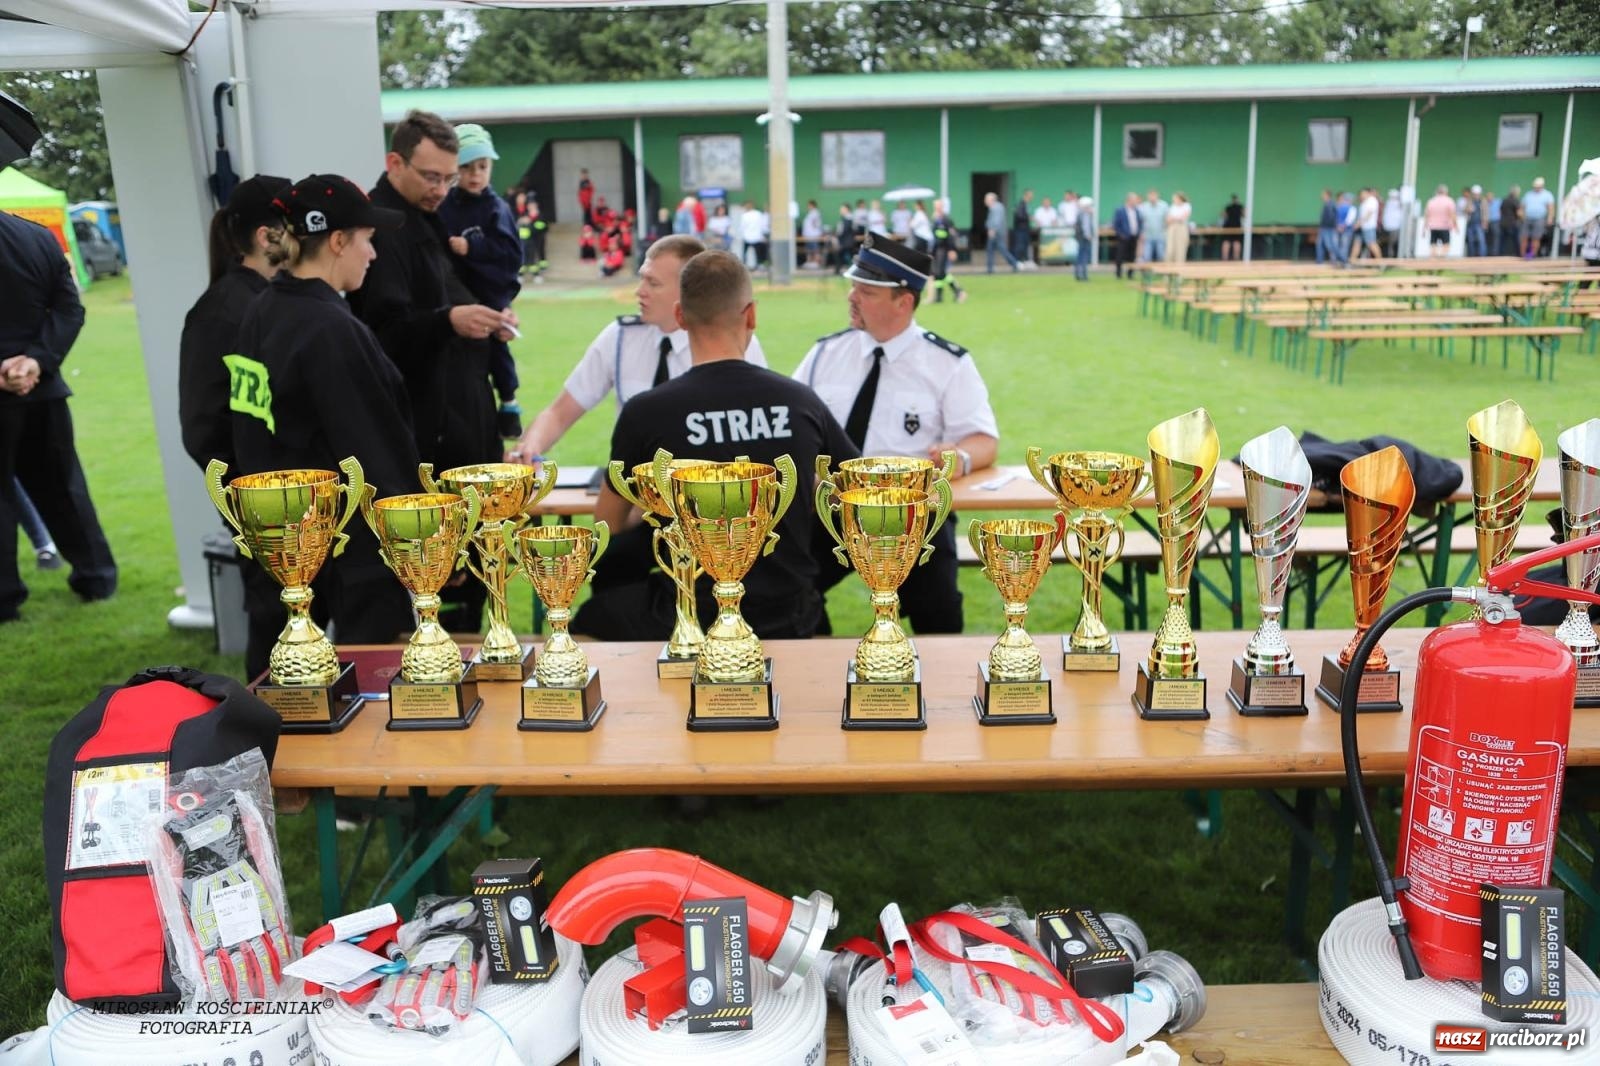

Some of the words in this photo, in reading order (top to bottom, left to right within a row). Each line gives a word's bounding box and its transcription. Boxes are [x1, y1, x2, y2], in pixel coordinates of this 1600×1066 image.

[686, 406, 792, 445] STRAŻ
[1456, 749, 1525, 767] GAŚNICA
[1442, 811, 1454, 821] A
[1483, 820, 1494, 830] B
[1522, 821, 1533, 831] C
[482, 898, 495, 918] 650
[1081, 910, 1108, 938] FLAGGER
[1102, 938, 1117, 950] 650
[1546, 906, 1560, 970] FLAGGER
[486, 919, 505, 972] FLAGGER
[729, 915, 744, 977] FLAGGER
[732, 980, 745, 1004] 650
[1548, 972, 1560, 997] 650
